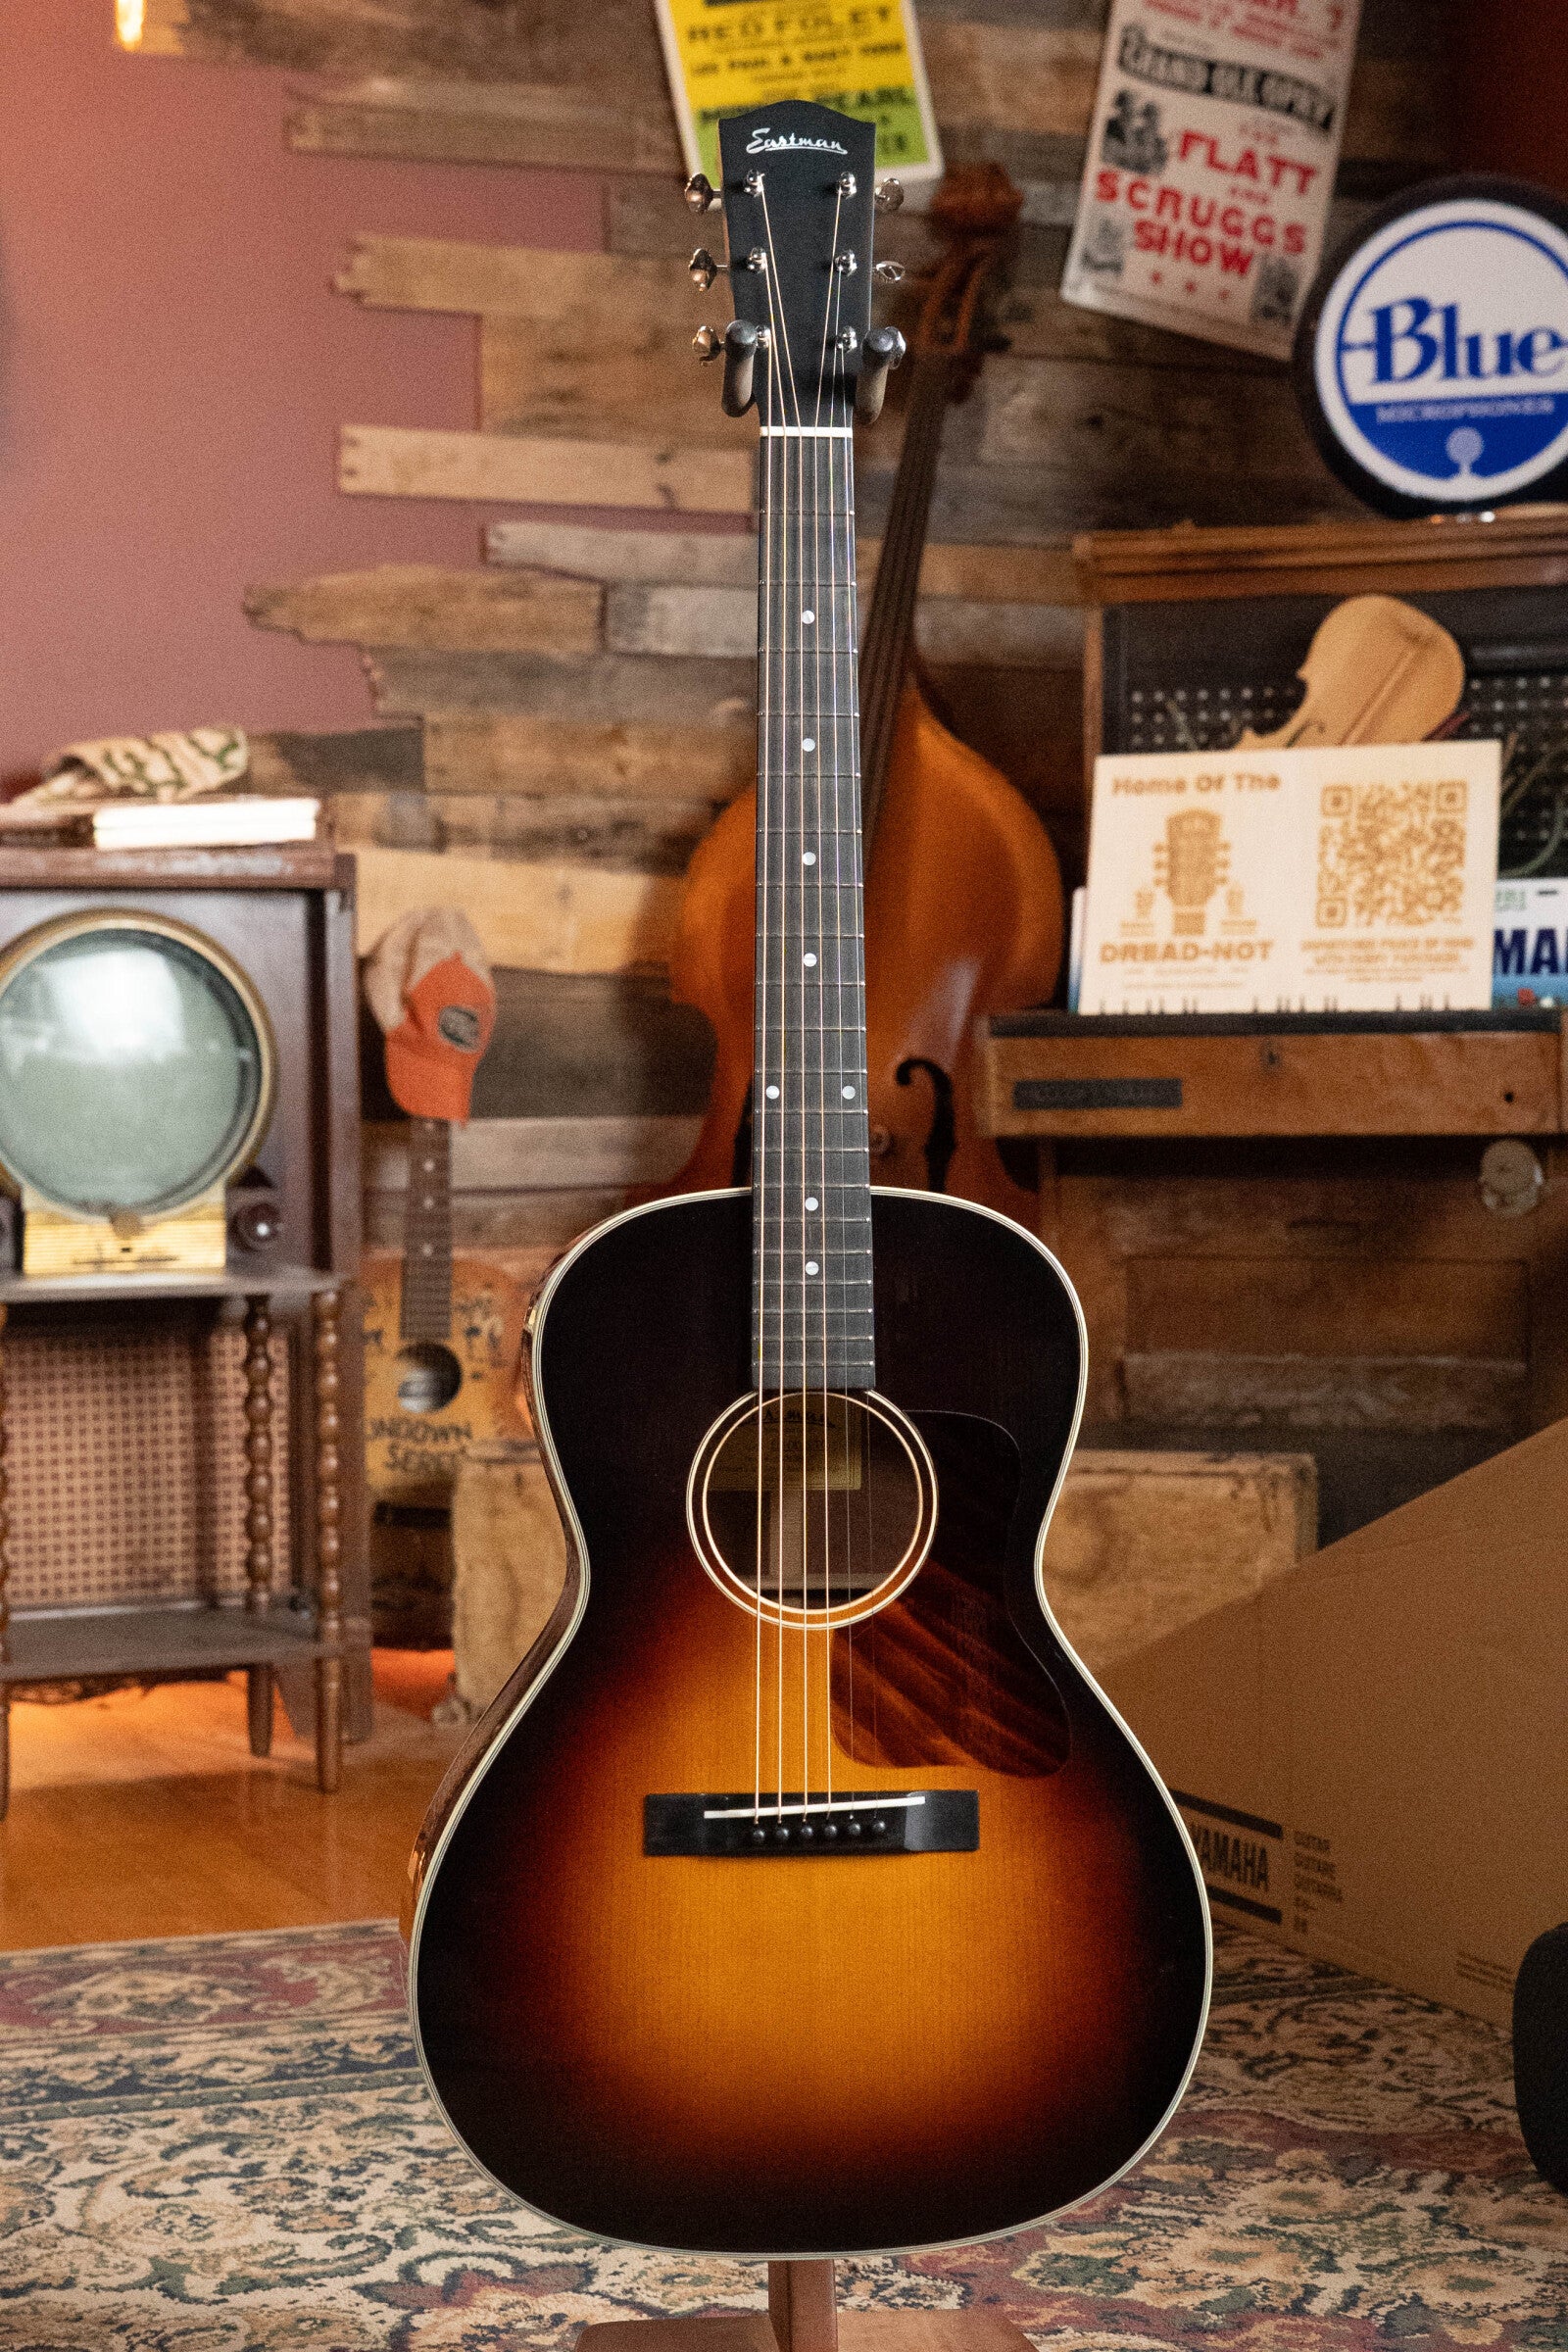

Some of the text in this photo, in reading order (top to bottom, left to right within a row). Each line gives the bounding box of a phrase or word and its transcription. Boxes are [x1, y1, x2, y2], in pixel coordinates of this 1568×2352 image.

[746, 127, 848, 155] Eastman
[1178, 128, 1319, 198] FLATT
[1095, 169, 1308, 256] SCRUGGS
[1133, 220, 1255, 277] SHOW
[1370, 297, 1567, 385] Blue
[1111, 771, 1281, 797] Home Of The
[1099, 938, 1274, 966] DREAD-NOT
[1493, 927, 1568, 977] MA
[1191, 1823, 1269, 1892] YAMAHA
